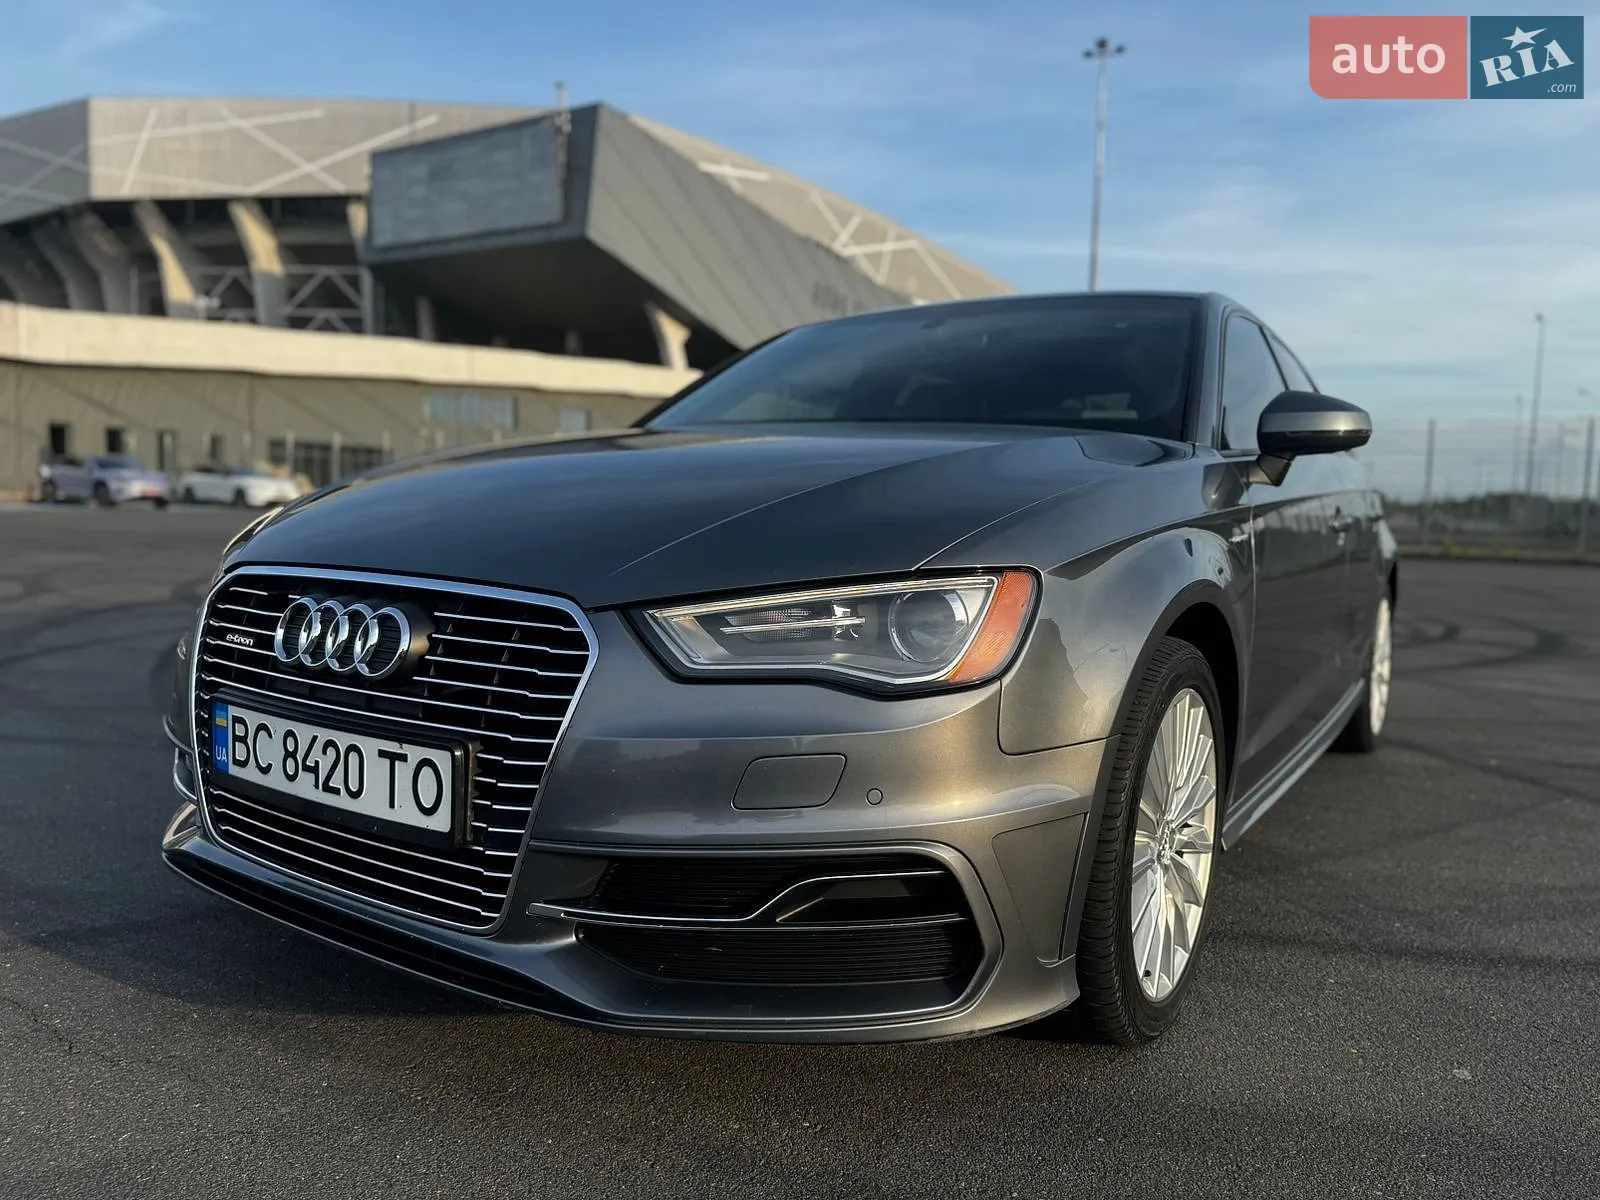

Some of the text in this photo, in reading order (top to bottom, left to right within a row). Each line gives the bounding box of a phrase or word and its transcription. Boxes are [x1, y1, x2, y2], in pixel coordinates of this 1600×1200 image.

[226, 633, 254, 646] e-tron
[215, 745, 228, 763] UA
[231, 714, 444, 817] BC 8420 TO
